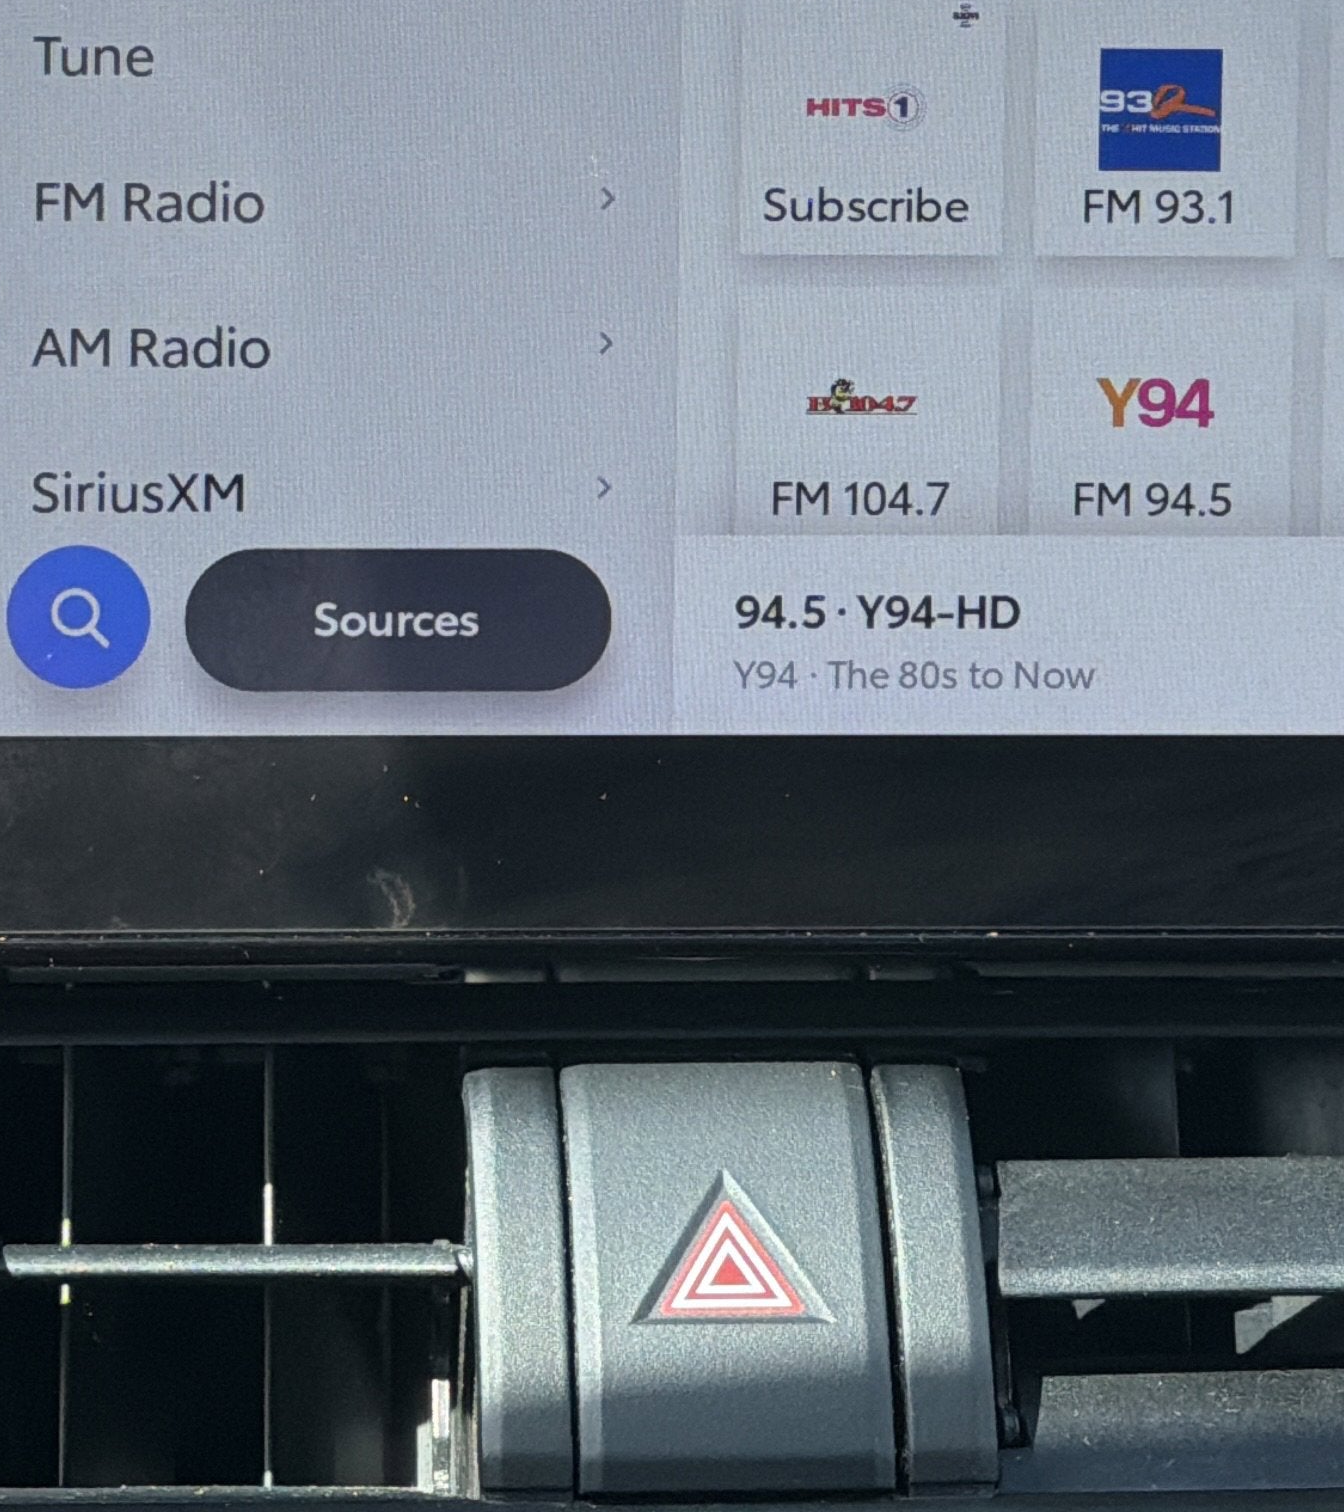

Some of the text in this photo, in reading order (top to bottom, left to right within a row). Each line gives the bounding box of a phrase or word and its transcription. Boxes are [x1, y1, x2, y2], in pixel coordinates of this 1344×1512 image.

[33, 35, 155, 78] Tune
[806, 98, 887, 117] HITS
[35, 180, 265, 224] FM Radio
[763, 186, 969, 224] Subscribe
[1083, 188, 1233, 225] FM 93.1
[32, 325, 271, 370] AM Radio
[1097, 377, 1215, 428] Y94
[32, 471, 244, 514] SiriusXM
[772, 481, 950, 517] FM 104.7
[1074, 482, 1232, 517] FM 94.5
[314, 601, 479, 638] Sources
[735, 594, 1021, 630] 94.5 Y94-HD
[733, 659, 1096, 690] Y94 The 80s to Now
